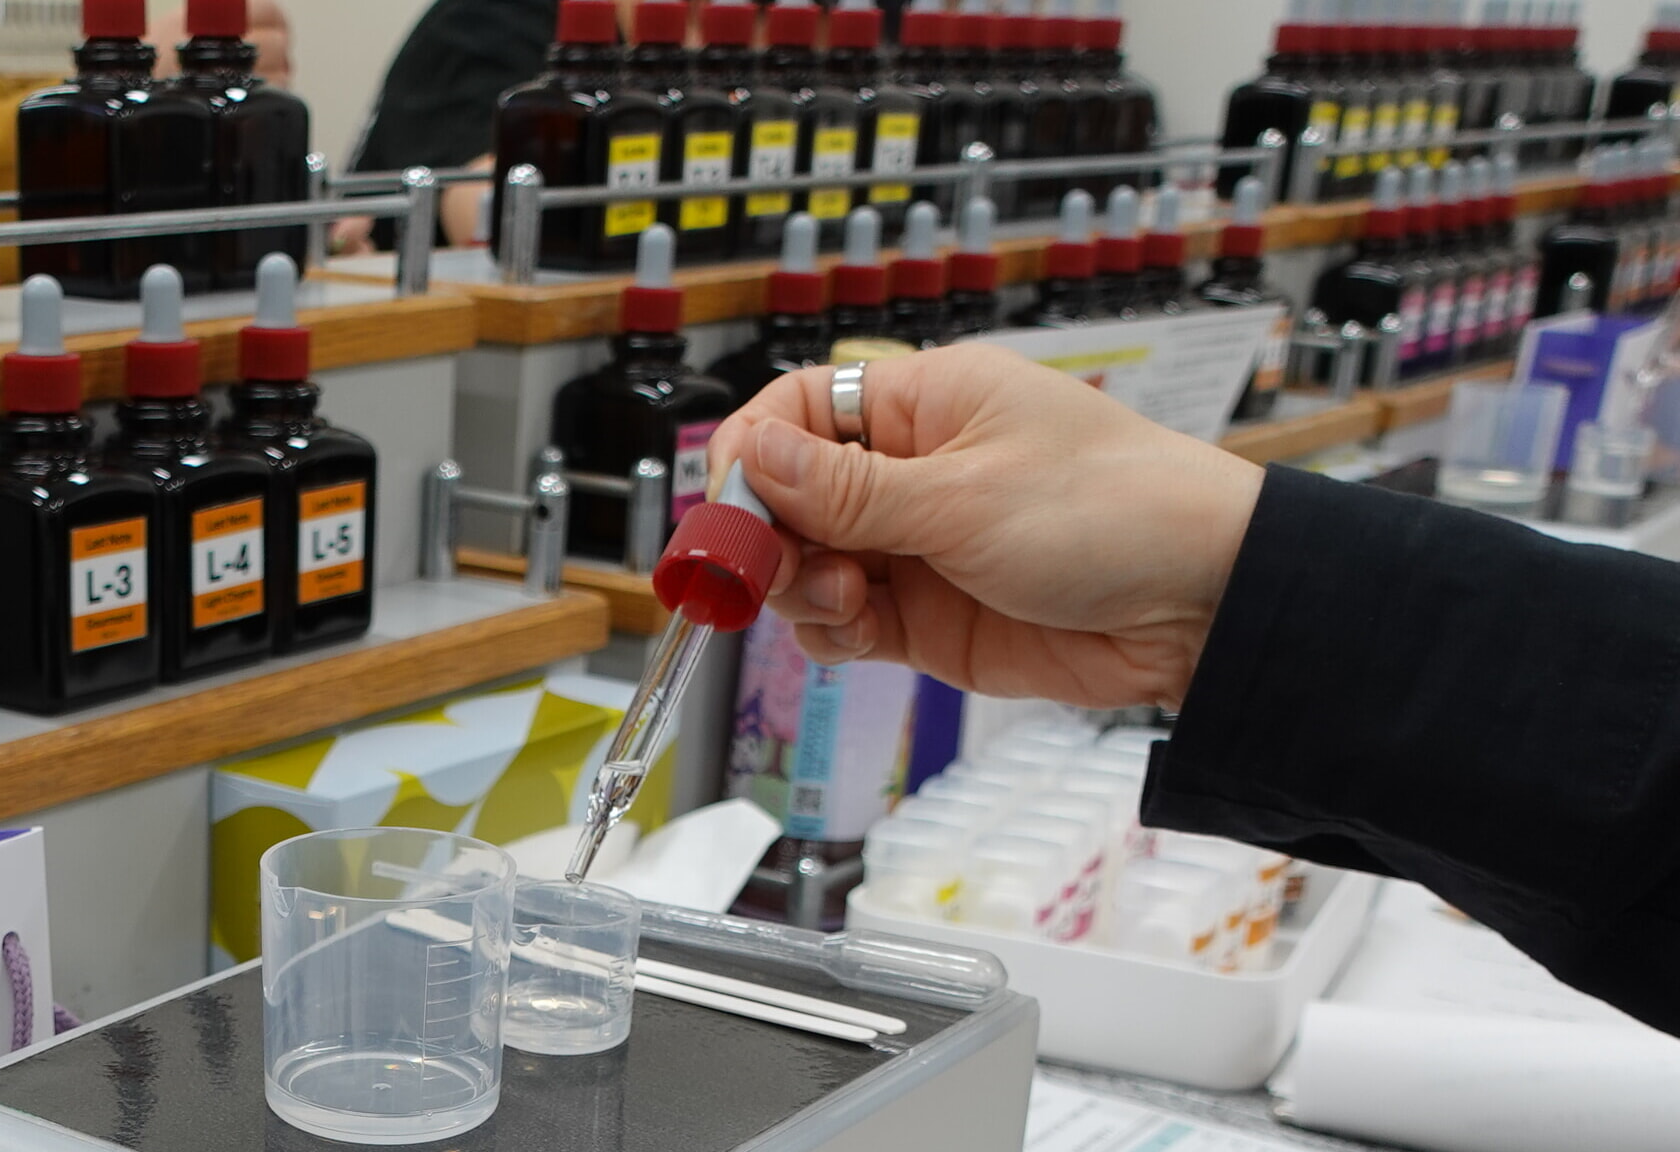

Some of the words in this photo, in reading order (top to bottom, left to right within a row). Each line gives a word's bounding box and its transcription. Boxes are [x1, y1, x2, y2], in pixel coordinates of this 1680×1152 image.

[313, 523, 352, 561] L-5
[207, 543, 250, 584] L-4
[86, 564, 132, 605] L-3
